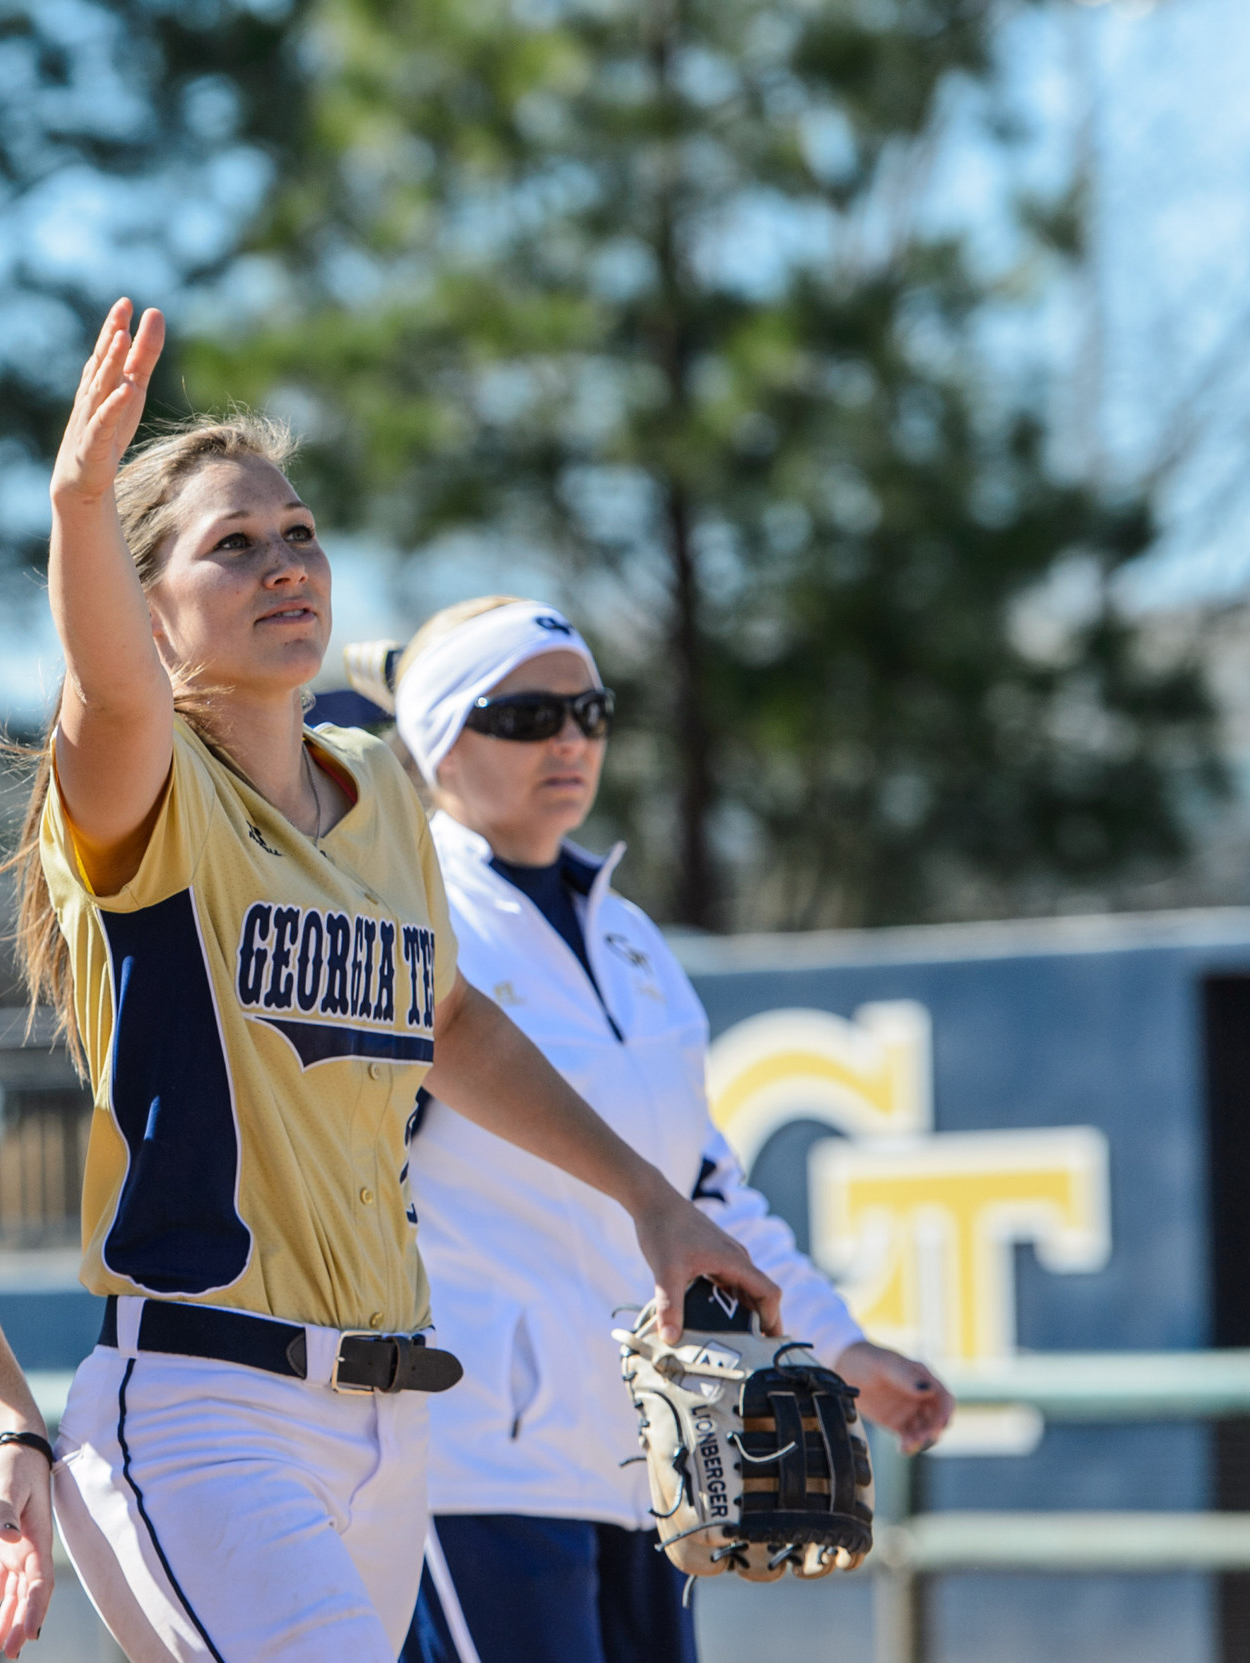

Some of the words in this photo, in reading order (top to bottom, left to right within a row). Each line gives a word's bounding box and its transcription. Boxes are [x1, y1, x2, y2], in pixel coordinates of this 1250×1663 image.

[237, 901, 396, 1024] GEORGIA
[401, 924, 436, 1029] TE
[690, 1403, 729, 1518] LIONBERGER
